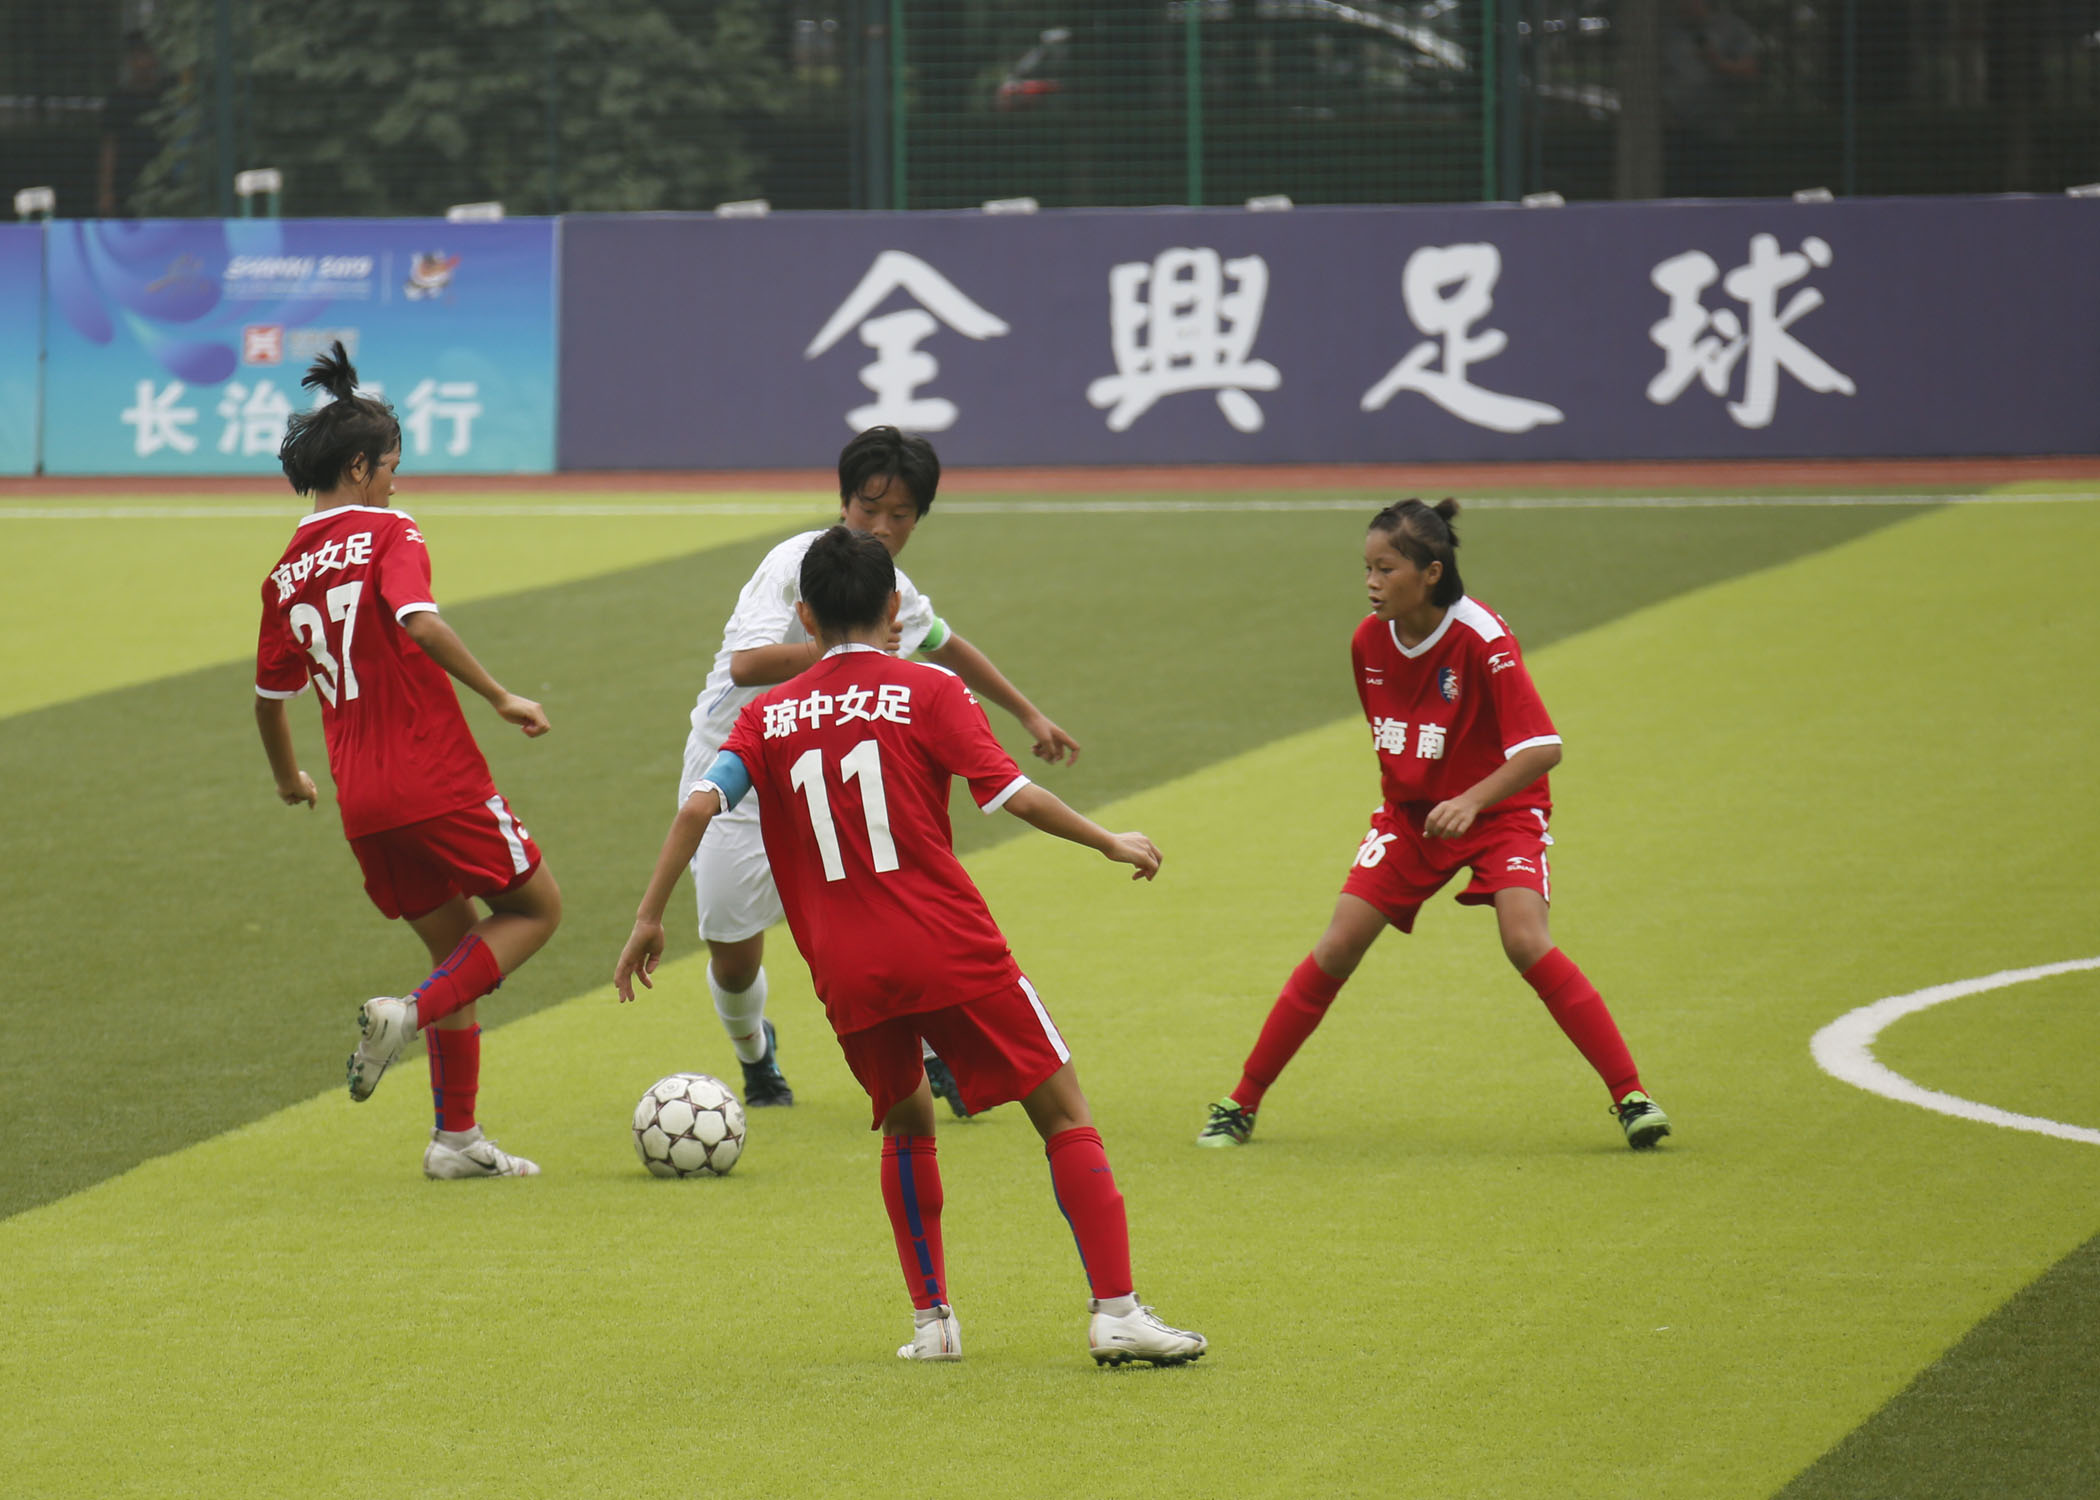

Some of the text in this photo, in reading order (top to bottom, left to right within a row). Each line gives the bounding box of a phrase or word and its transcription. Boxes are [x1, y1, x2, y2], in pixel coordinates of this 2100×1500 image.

[804, 233, 1856, 433] 全興足球
[121, 380, 482, 455] 长治行
[270, 531, 373, 603] 琼中女足
[288, 581, 364, 709] 37
[763, 684, 912, 740] 琼中女足
[1373, 716, 1447, 760] 海南
[789, 739, 900, 882] 11
